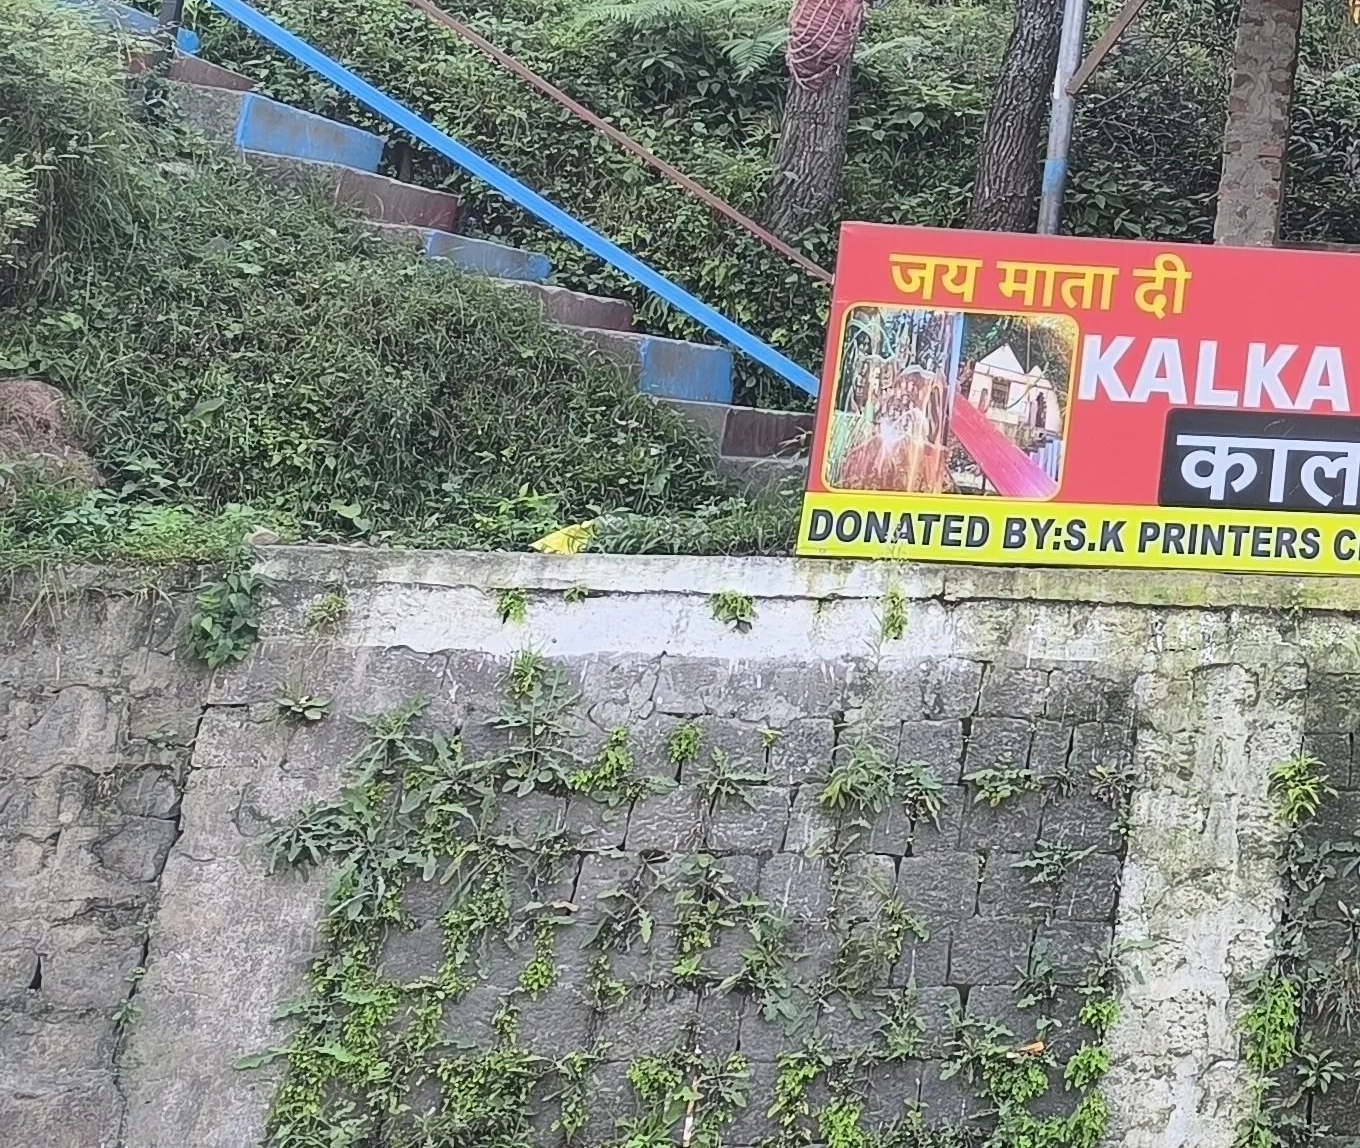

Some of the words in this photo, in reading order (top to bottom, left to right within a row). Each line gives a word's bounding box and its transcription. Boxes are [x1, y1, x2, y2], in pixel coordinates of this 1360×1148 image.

[889, 253, 983, 302] जय
[996, 260, 1120, 311] माता
[1132, 253, 1192, 319] दी
[1078, 334, 1350, 412] KALKA
[808, 508, 990, 548] DONATED
[1138, 522, 1319, 560] PRINTERS
